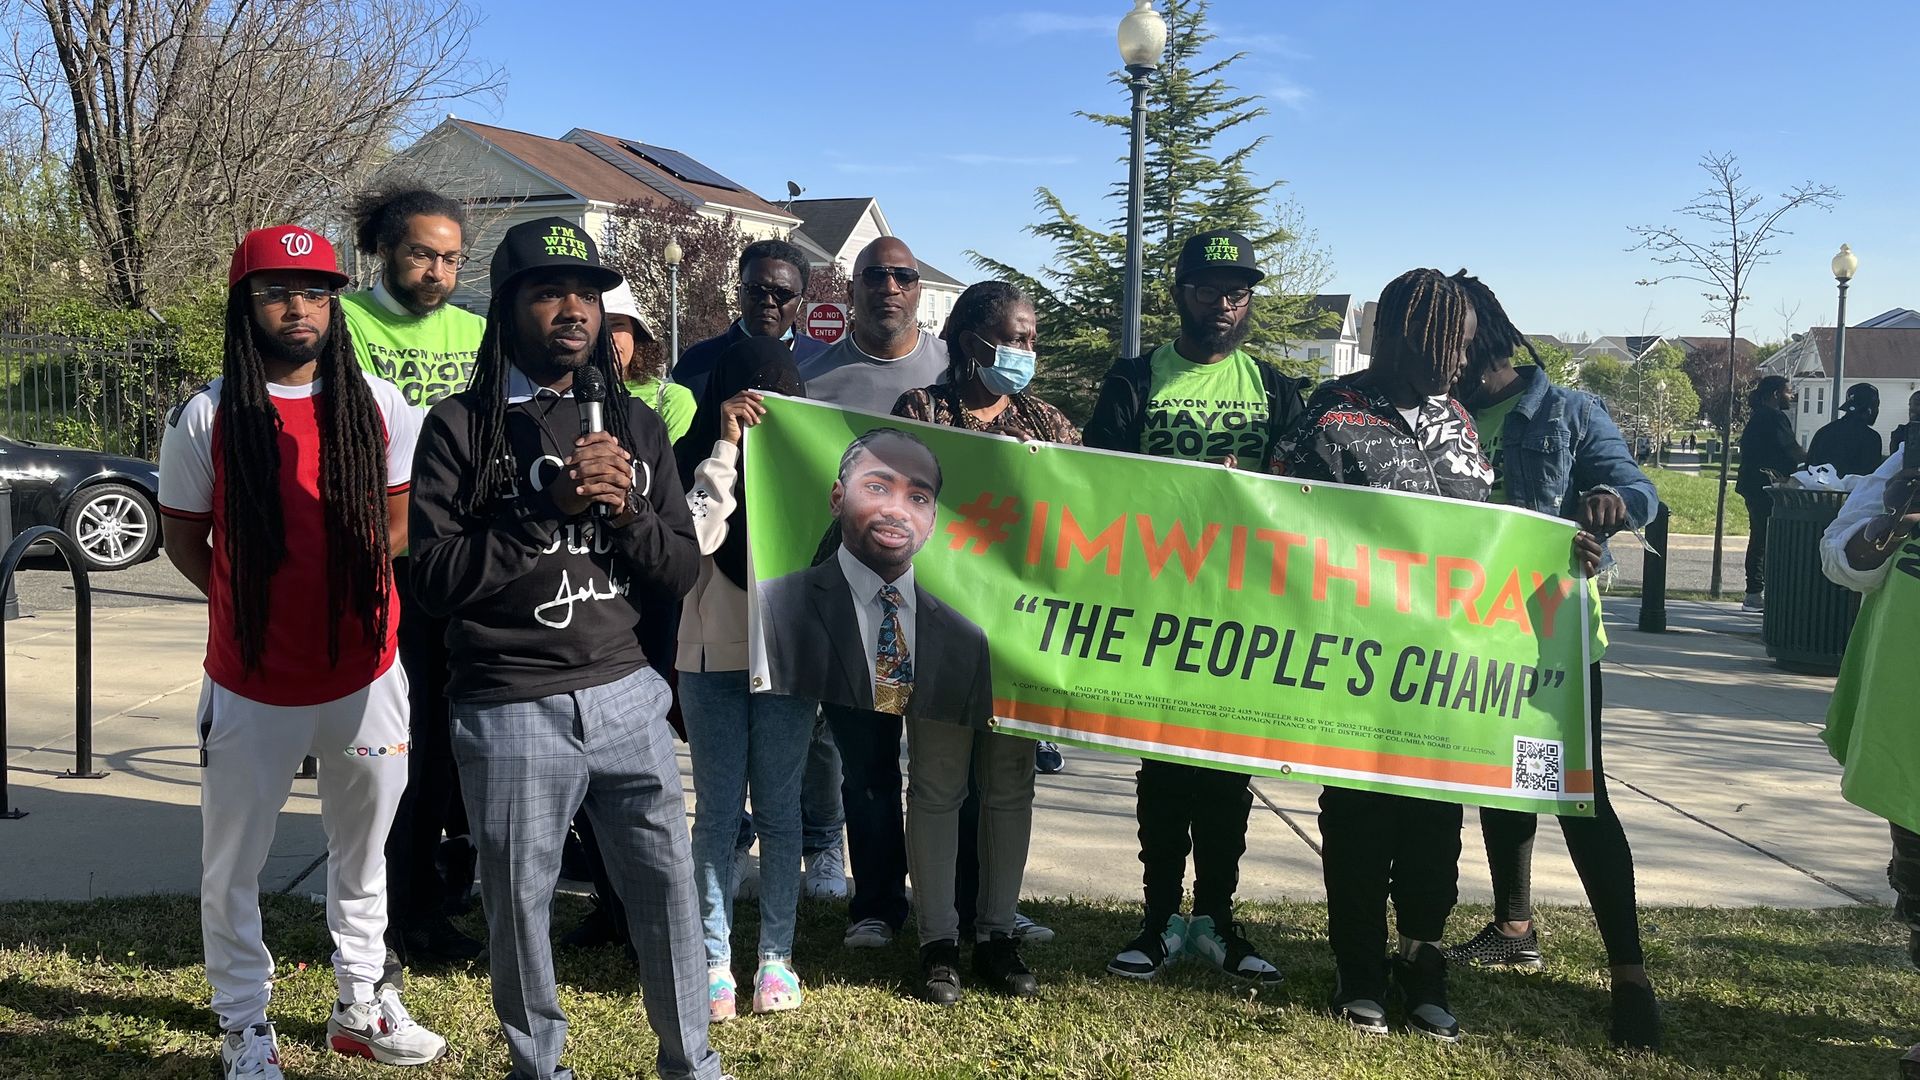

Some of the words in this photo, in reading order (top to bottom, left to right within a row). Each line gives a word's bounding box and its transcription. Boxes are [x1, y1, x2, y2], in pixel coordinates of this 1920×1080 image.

[550, 226, 576, 238] I'M
[280, 232, 313, 256] W
[542, 236, 587, 251] WITH
[1210, 237, 1230, 246] I'M
[545, 246, 588, 260] TRAY
[1204, 245, 1238, 254] WITH
[1204, 253, 1239, 261] TRAY
[813, 311, 823, 319] DO
[826, 311, 841, 319] NOT
[815, 329, 837, 337] ENTER
[368, 342, 428, 360] TRAYON
[1148, 398, 1207, 410] RAYON
[1148, 430, 1264, 457] 2022
[944, 491, 1574, 638] #IMWITHTRAY
[1013, 594, 1135, 663] “THE
[1142, 612, 1383, 697] PEOPLE'S
[1390, 645, 1565, 719] CHAMP”
[1019, 682, 1039, 690] COPY
[1053, 688, 1069, 696] OUR
[1070, 691, 1100, 701] REPORT
[1112, 697, 1135, 705] FILED
[1137, 701, 1158, 709] WITH
[1178, 707, 1217, 716] DIRECTOR
[1231, 714, 1271, 725] CAMPAIGN
[1273, 720, 1306, 730] FINANCE
[1320, 726, 1335, 734] THE
[1338, 728, 1372, 739] DISTRICT
[1385, 735, 1426, 746] COLUMBIA
[1427, 741, 1452, 749] BOARD
[1462, 746, 1496, 756] ELECTIONS
[1074, 685, 1092, 693] PAID
[1094, 687, 1109, 695] FOR
[1145, 695, 1172, 704] WHITE
[1190, 702, 1216, 710] MAYOR
[1253, 711, 1292, 720] WHEELER
[1317, 719, 1335, 727] WDC
[1336, 722, 1357, 730] 20032
[1359, 724, 1402, 736] TREASURER
[1423, 734, 1450, 742] MOORE
